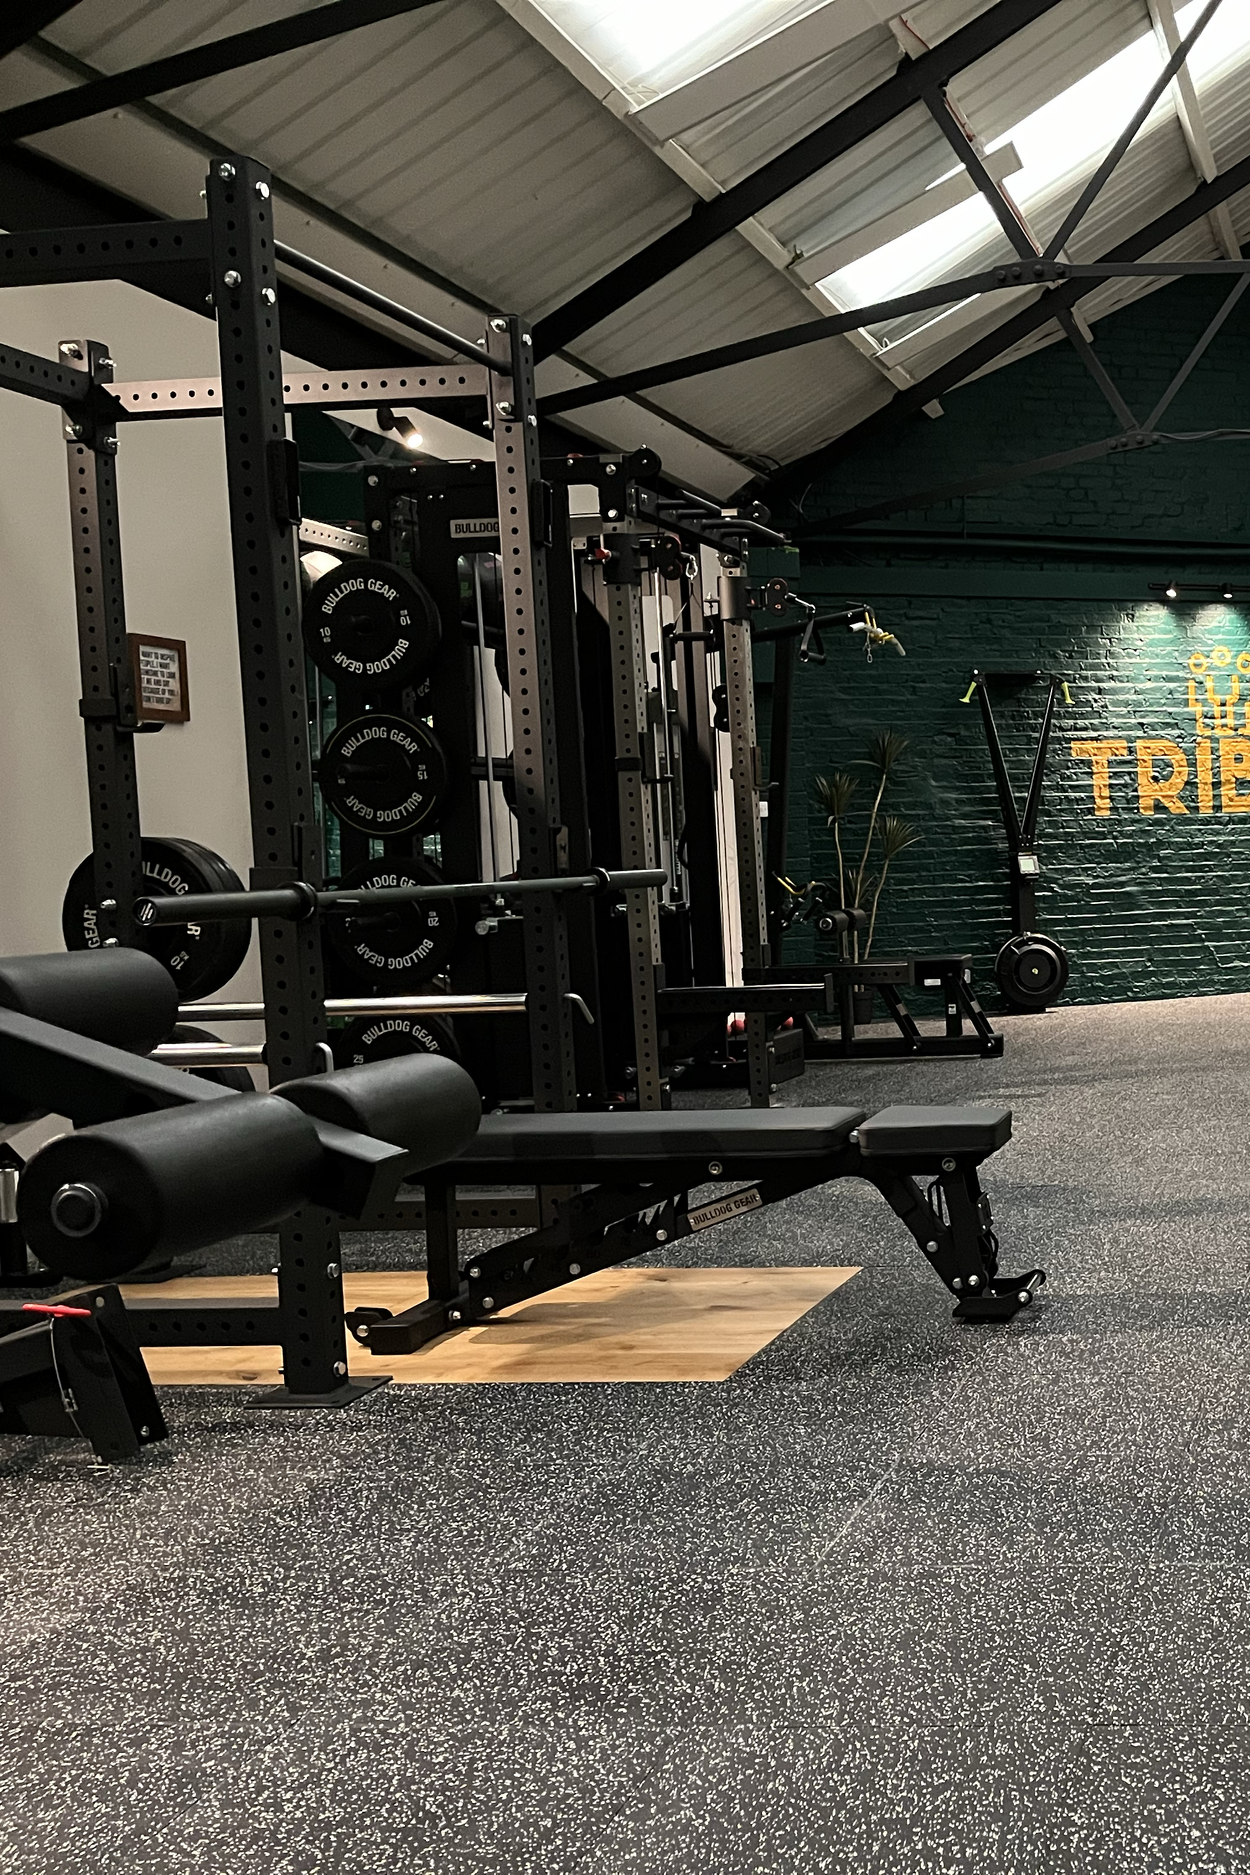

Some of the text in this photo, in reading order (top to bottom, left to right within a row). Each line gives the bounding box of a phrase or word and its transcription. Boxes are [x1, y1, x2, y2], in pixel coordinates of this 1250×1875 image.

[455, 522, 499, 534] BULLDOG
[321, 578, 397, 614] BULLDOG GEAR
[319, 626, 331, 637] 10
[400, 615, 411, 626] 10
[334, 638, 410, 674] BULLDOG GEAR
[341, 727, 418, 757] BULLDOG GEAR
[417, 770, 428, 780] 15
[345, 792, 423, 822] BULLDOG GEAR
[83, 909, 100, 949] GEAR
[427, 917, 440, 927] 20
[170, 956, 186, 970] 10
[356, 939, 434, 969] BULLDOG GEAR
[361, 1020, 439, 1051] BULLDOG GEAR
[353, 1054, 364, 1064] 25
[692, 1203, 732, 1225] BULLDOG
